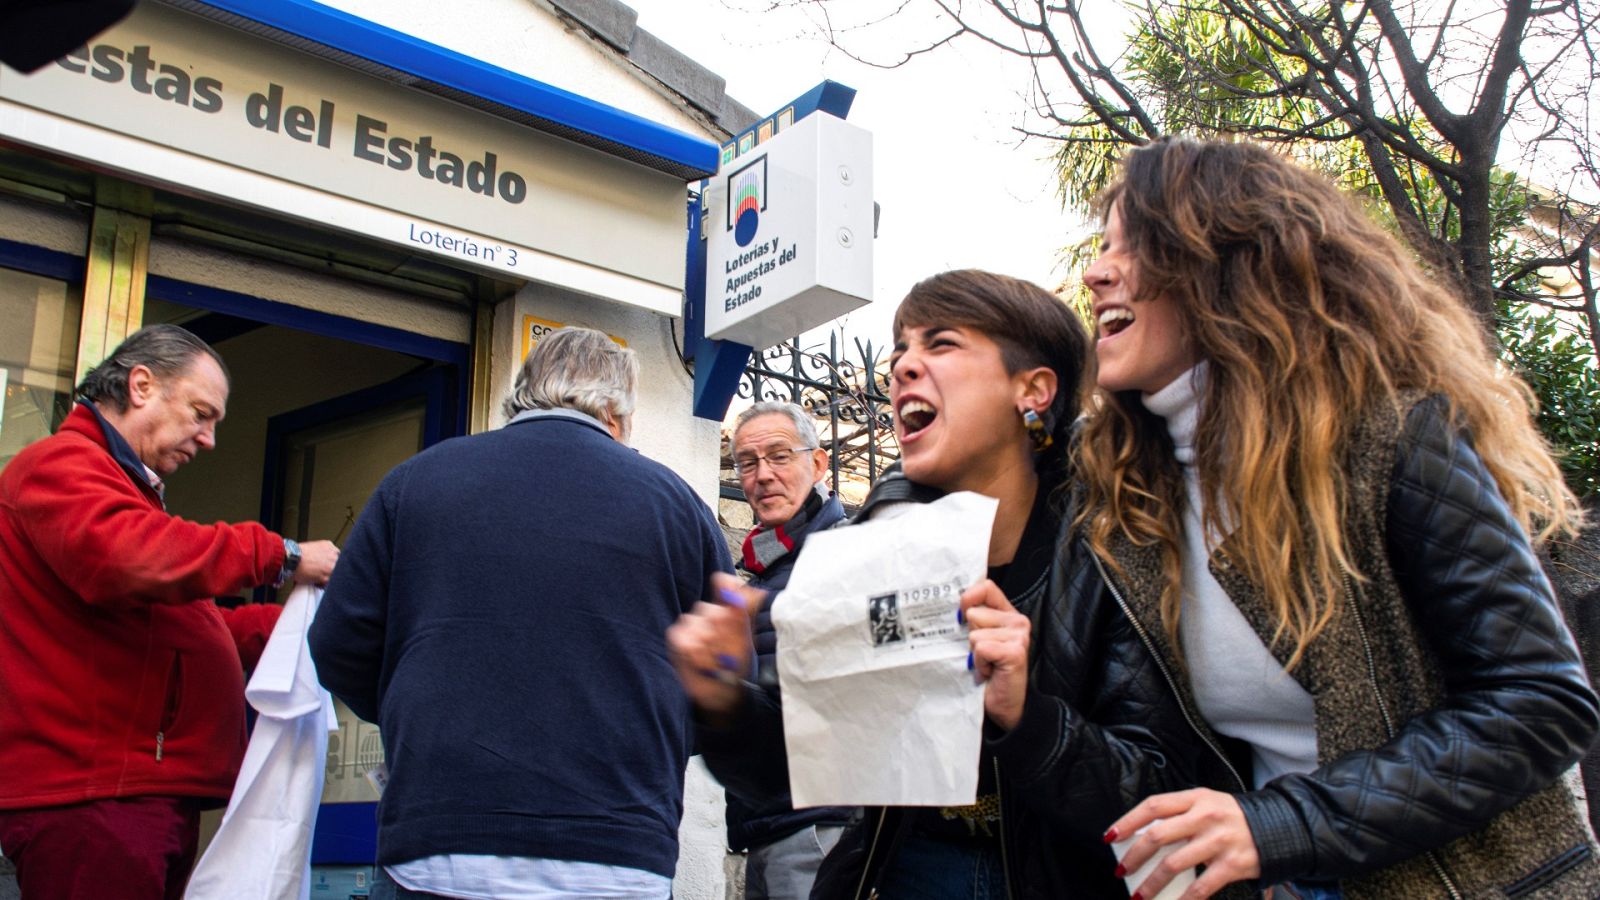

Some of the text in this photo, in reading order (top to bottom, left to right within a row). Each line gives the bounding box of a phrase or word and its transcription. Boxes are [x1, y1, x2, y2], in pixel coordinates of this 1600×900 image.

[245, 82, 335, 150] del
[353, 114, 527, 205] Estado
[409, 223, 479, 258] Lotería
[506, 248, 518, 267] 3
[725, 236, 779, 275] Loterías y
[725, 243, 797, 294] Apuestas del
[724, 284, 762, 313] Estado
[903, 584, 952, 602] 10989
